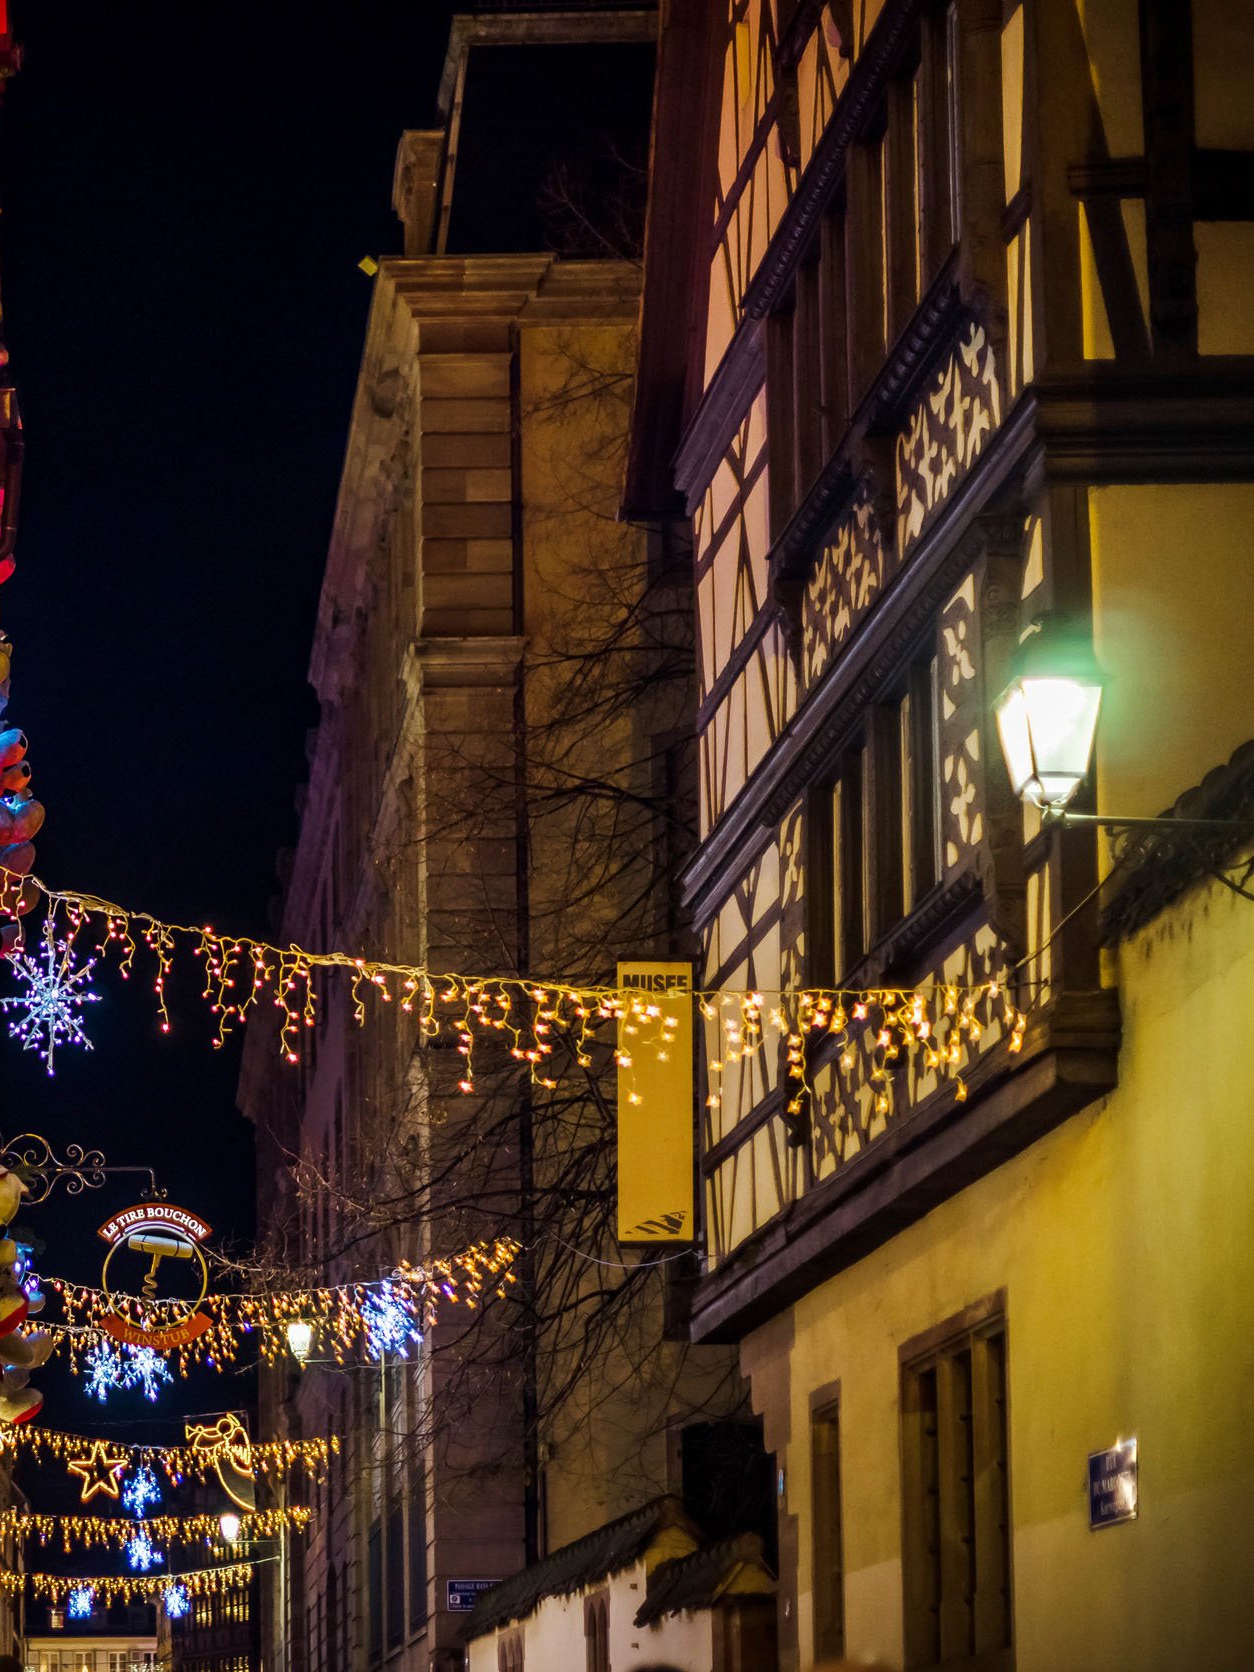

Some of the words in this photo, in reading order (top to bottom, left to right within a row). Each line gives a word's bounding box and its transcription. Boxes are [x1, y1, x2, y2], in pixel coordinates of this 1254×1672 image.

[103, 1221, 118, 1238] LE
[116, 1208, 145, 1228] TIRE
[146, 1207, 207, 1237] BOUCHON
[123, 1328, 191, 1347] WINSTUB
